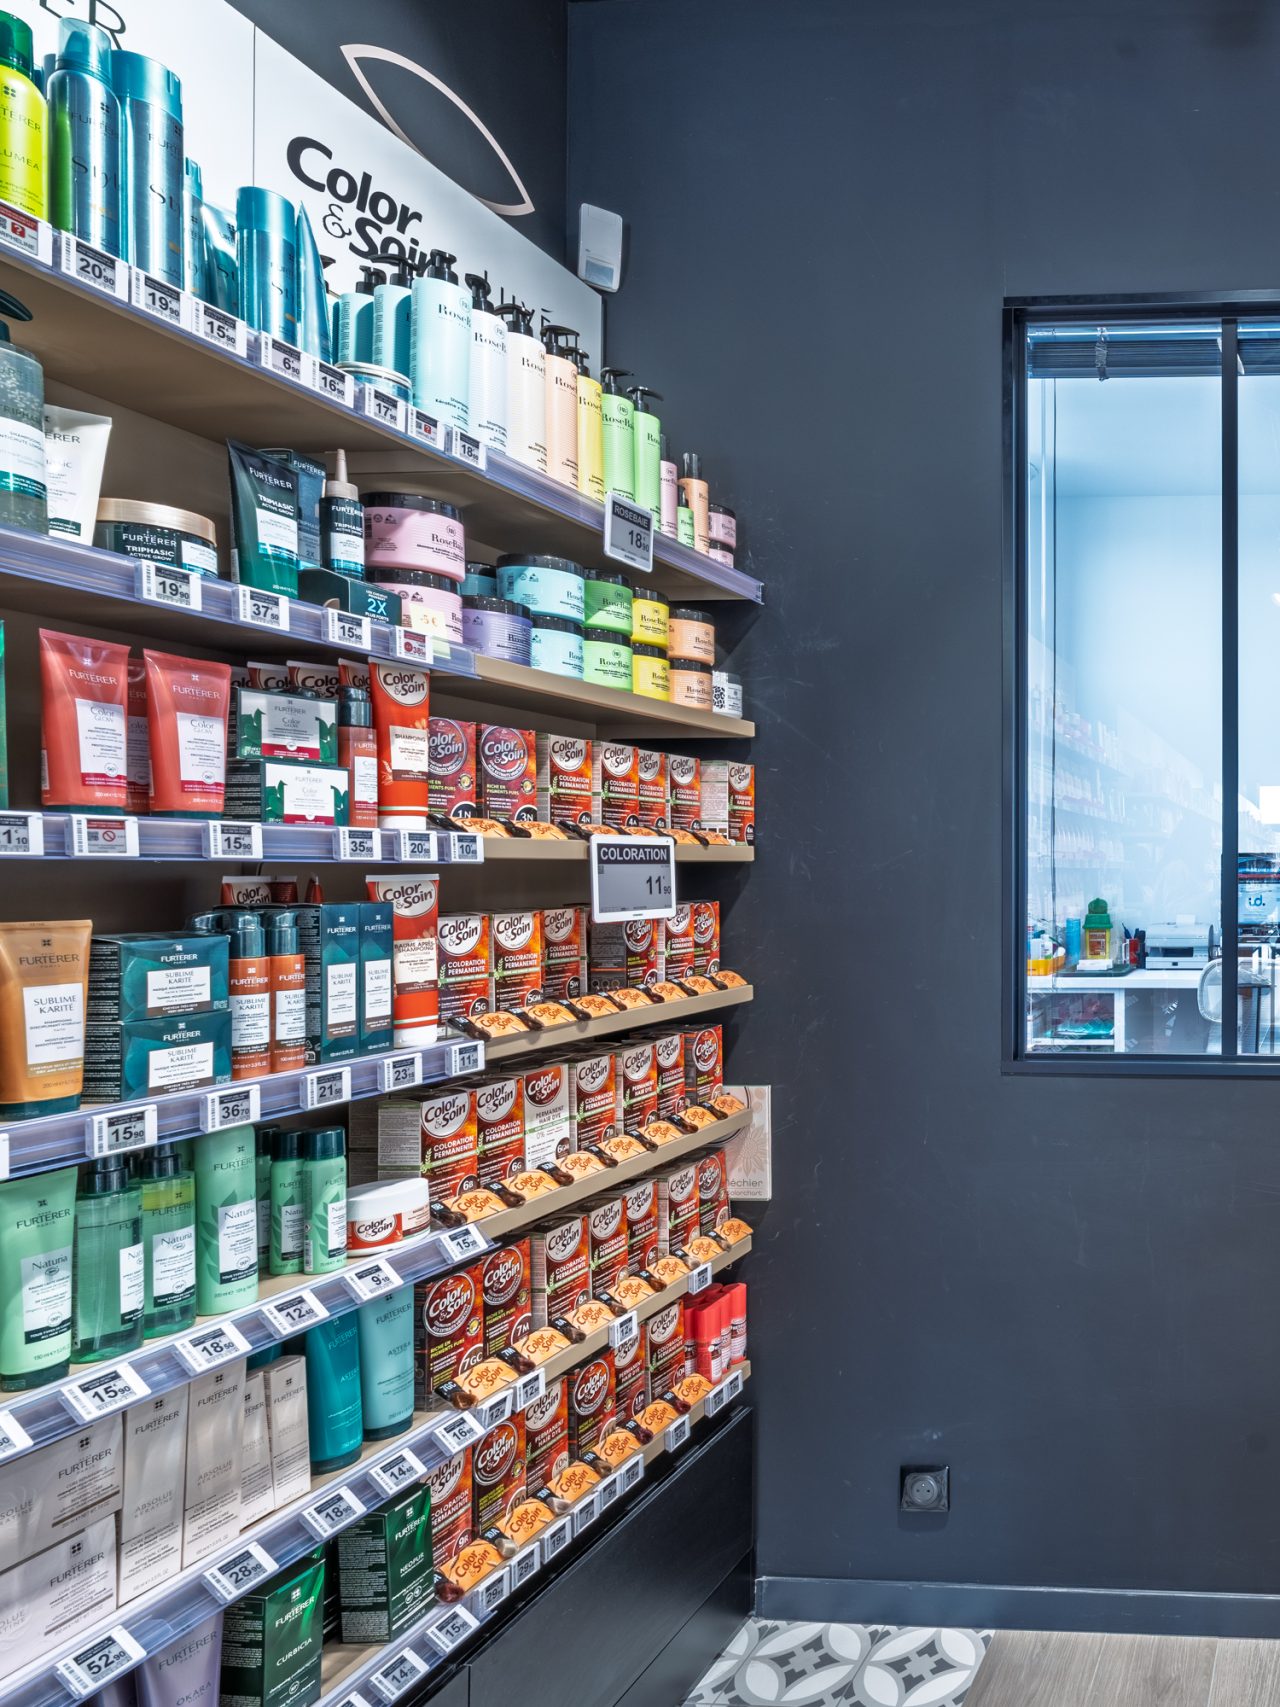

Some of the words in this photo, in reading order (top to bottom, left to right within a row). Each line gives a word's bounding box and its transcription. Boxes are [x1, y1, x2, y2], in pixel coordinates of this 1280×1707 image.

[287, 136, 422, 234] Color
[614, 505, 649, 528] ROSEBAIE
[122, 532, 177, 547] FURTERER
[125, 545, 175, 557] TRIPHASIC
[367, 598, 387, 616] 2X
[69, 668, 118, 685] FURTERER
[382, 672, 416, 687] Color
[173, 684, 220, 699] FURTERER
[401, 680, 425, 695] Soin
[485, 738, 517, 756] Color
[552, 739, 577, 753] Color
[500, 748, 524, 764] Soin
[600, 847, 667, 861] COLORATION
[382, 881, 423, 902] Color
[403, 889, 433, 909] Soin
[327, 926, 356, 934] FURTERER
[439, 919, 471, 939] Color
[496, 915, 524, 935] Color
[510, 923, 530, 941] Soin
[455, 928, 478, 946] Soin
[19, 954, 79, 965] FURTERER
[160, 953, 198, 962] FURTERER
[448, 959, 486, 968] COLORATION
[505, 953, 537, 962] COLORATION
[505, 959, 537, 969] PERMANENTE
[165, 970, 194, 978] SUBLIME
[448, 966, 486, 975] PERMANENTE
[231, 976, 269, 985] FURTERER
[34, 996, 77, 1006] SUBLIME
[475, 1003, 486, 1011] 5G
[163, 1030, 200, 1041] FURTERER
[528, 1072, 553, 1095] Color
[478, 1083, 506, 1108] Color
[492, 1091, 513, 1112] Soin
[425, 1096, 458, 1123] Color
[442, 1106, 466, 1127] Soin
[535, 1106, 564, 1119] PERMANENT
[485, 1121, 521, 1135] COLORATION
[485, 1127, 521, 1142] PERMANENTE
[434, 1136, 474, 1151] COLORATION
[434, 1143, 474, 1159] PERMANENTE
[511, 1161, 522, 1171] 6G
[16, 1208, 71, 1230] FURTERER
[357, 1218, 386, 1234] Color
[548, 1224, 573, 1249] Color
[32, 1254, 68, 1271] Naturia
[485, 1258, 513, 1286] Color
[555, 1256, 586, 1274] COLORATION
[556, 1263, 586, 1281] PERMANENTE
[499, 1263, 520, 1288] Soin
[429, 1283, 463, 1317] Color
[446, 1290, 471, 1318] Soin
[376, 1303, 412, 1325] FURTERER
[650, 1309, 671, 1334] Color
[517, 1322, 529, 1333] 7M
[328, 1327, 357, 1349] FURTERER
[463, 1352, 483, 1370] 7GC
[468, 1366, 491, 1388] Color
[577, 1372, 602, 1400] Color
[198, 1385, 238, 1407] FURTERER
[135, 1410, 180, 1434] FURTERER
[535, 1419, 564, 1442] PERMANENT
[538, 1436, 550, 1447] HAIR
[550, 1428, 561, 1439] DYE
[478, 1430, 507, 1468] Color
[490, 1436, 514, 1468] Soin
[58, 1448, 112, 1479] FURTERER
[560, 1470, 579, 1492] Color
[395, 1514, 425, 1541] FURTERER
[509, 1508, 530, 1533] Color
[524, 1507, 542, 1529] Soin
[458, 1534, 468, 1545] 9R
[49, 1552, 105, 1587] FURTERER
[400, 1552, 425, 1573] NEOPUR
[455, 1550, 479, 1577] Color
[472, 1549, 490, 1574] Soin
[275, 1596, 315, 1628] FURTERER
[159, 1630, 217, 1671] FURTERER
[276, 1638, 313, 1666] CURBICIA
